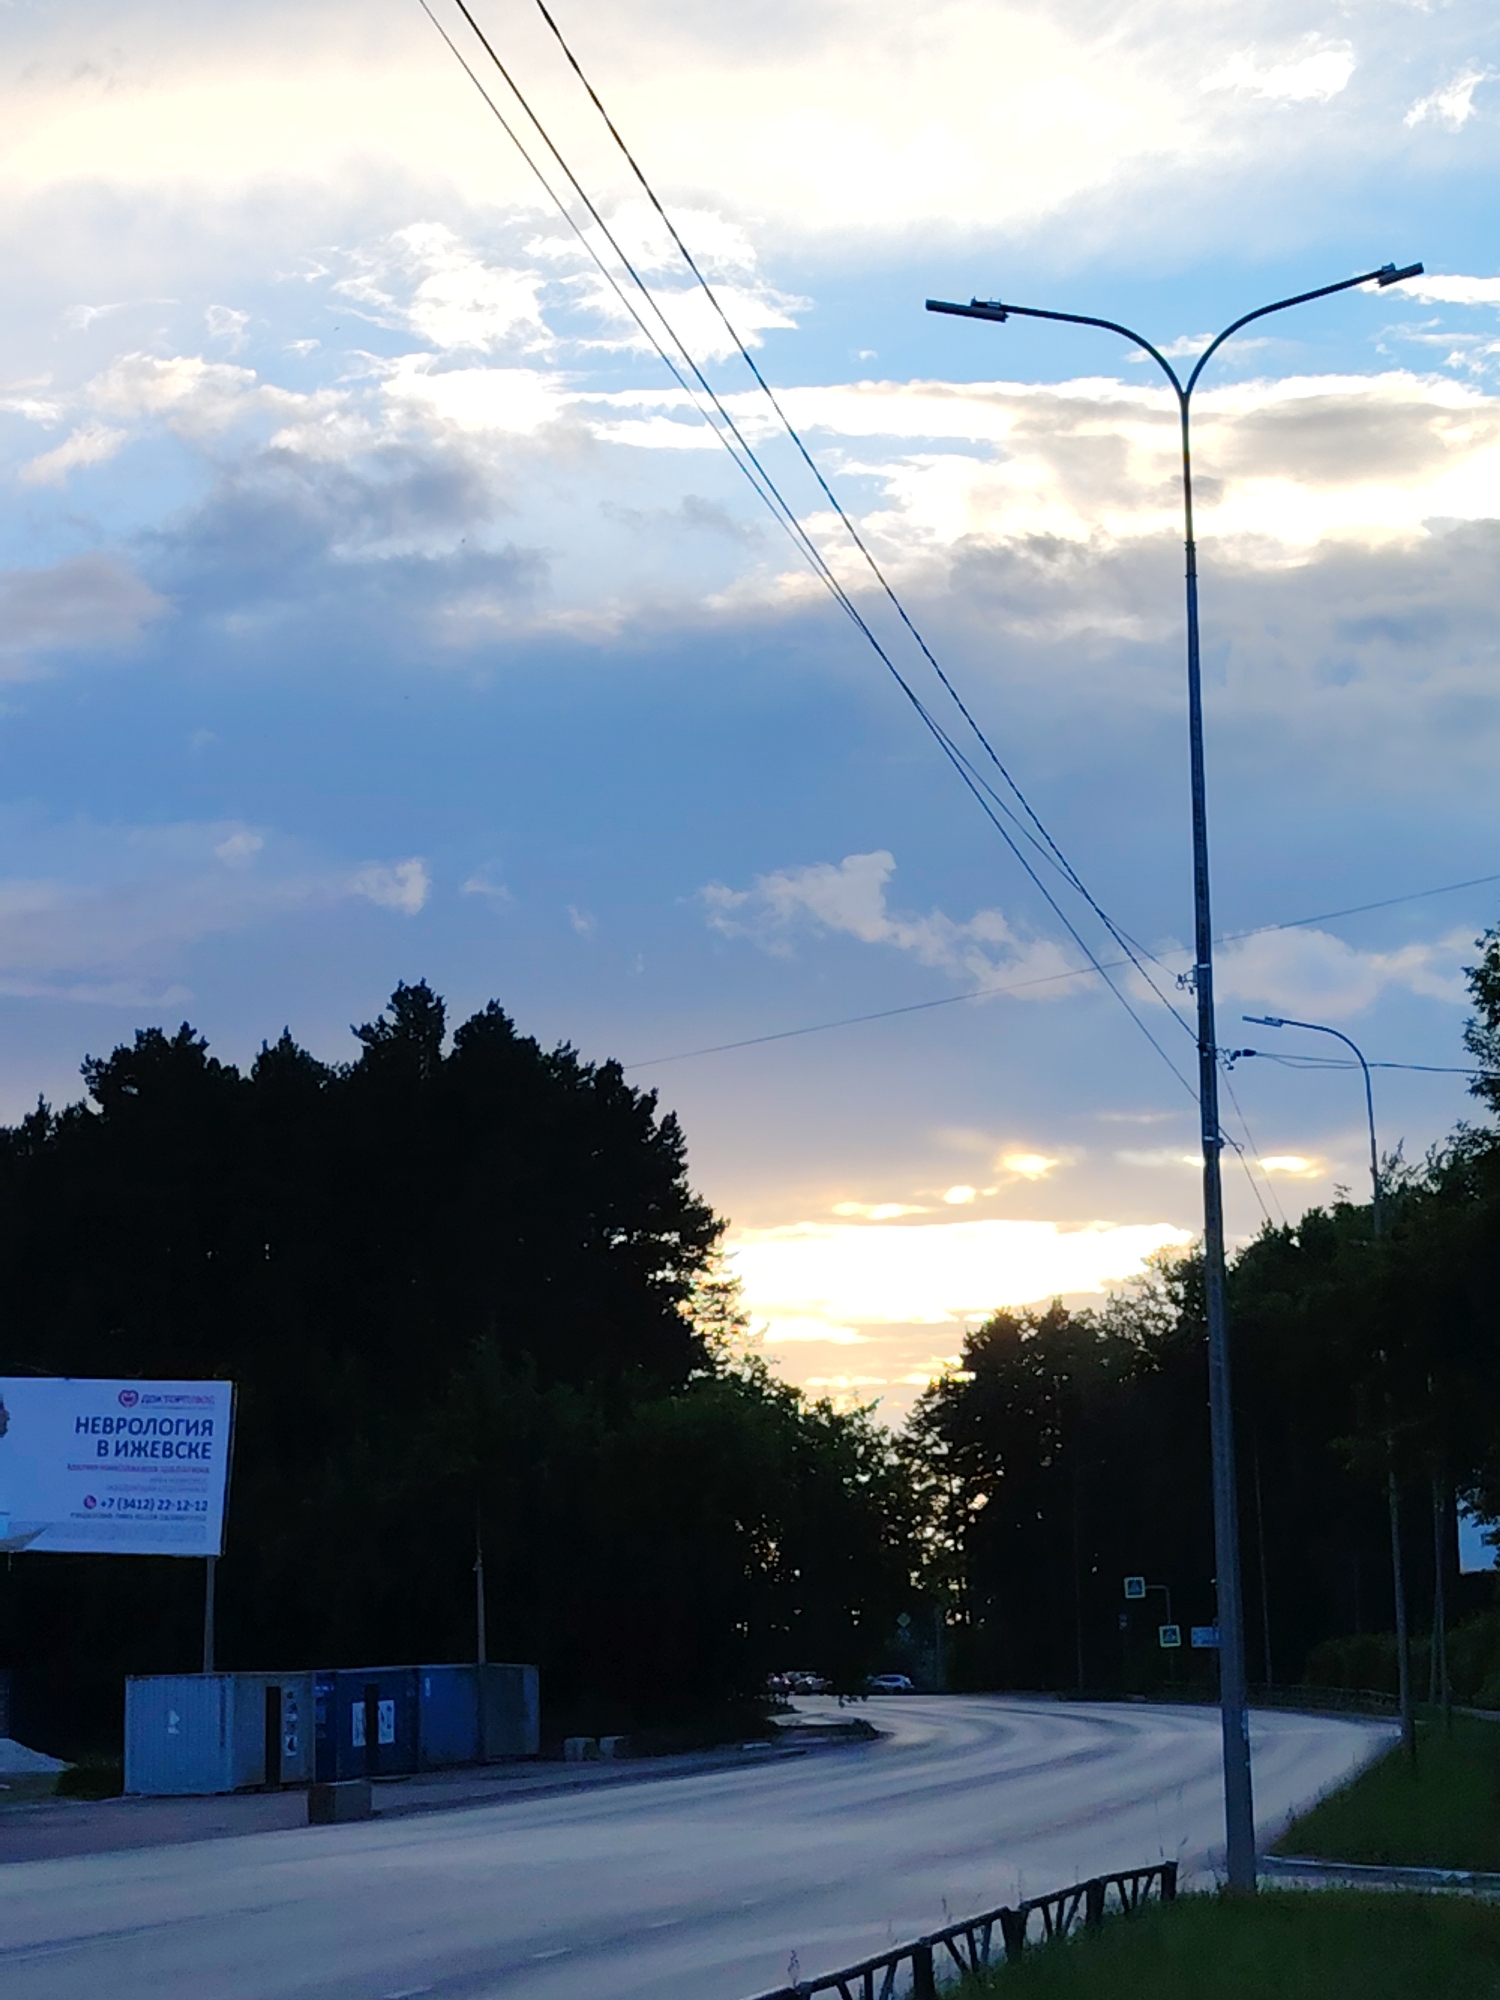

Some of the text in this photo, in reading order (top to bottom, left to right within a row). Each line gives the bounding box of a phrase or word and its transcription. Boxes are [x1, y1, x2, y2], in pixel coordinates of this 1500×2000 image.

[75, 1416, 214, 1437] НЕВРОЛОГИЯ
[97, 1439, 213, 1460] В ИЖЕВСКЕ
[101, 1497, 208, 1512] +7 (3412) 22-12-12
